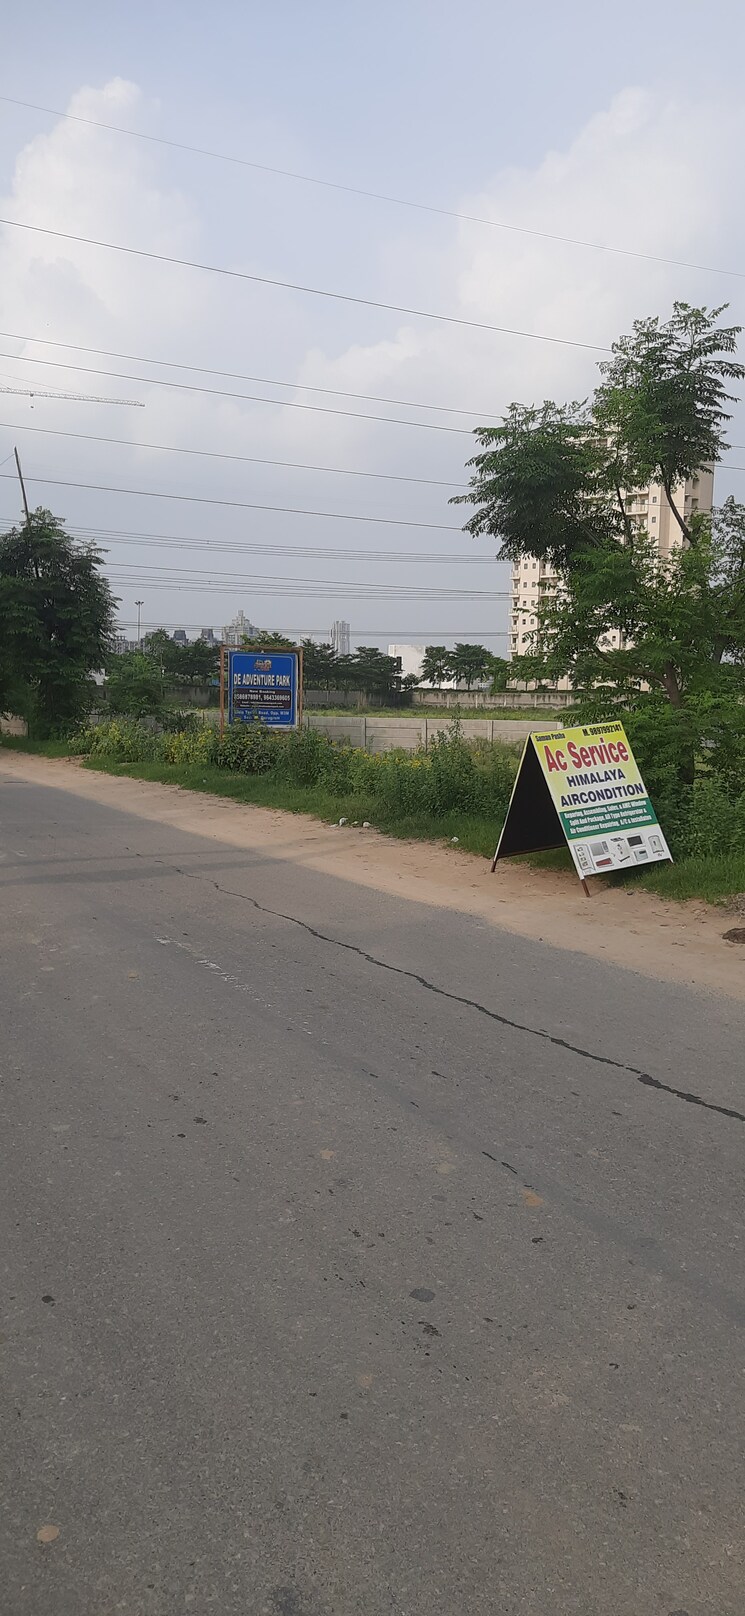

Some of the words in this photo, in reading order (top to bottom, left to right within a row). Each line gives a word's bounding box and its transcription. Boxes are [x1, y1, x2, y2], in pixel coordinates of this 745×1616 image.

[234, 674, 241, 685] DE
[242, 674, 275, 686] ADVENTURE
[276, 675, 290, 687] PARK
[582, 729, 590, 737] M.
[544, 745, 568, 772] Ac
[567, 737, 629, 769] Service
[566, 768, 626, 787] HIMALAYA
[560, 783, 644, 807] AIRCONDITION
[576, 824, 600, 833] Conditioner
